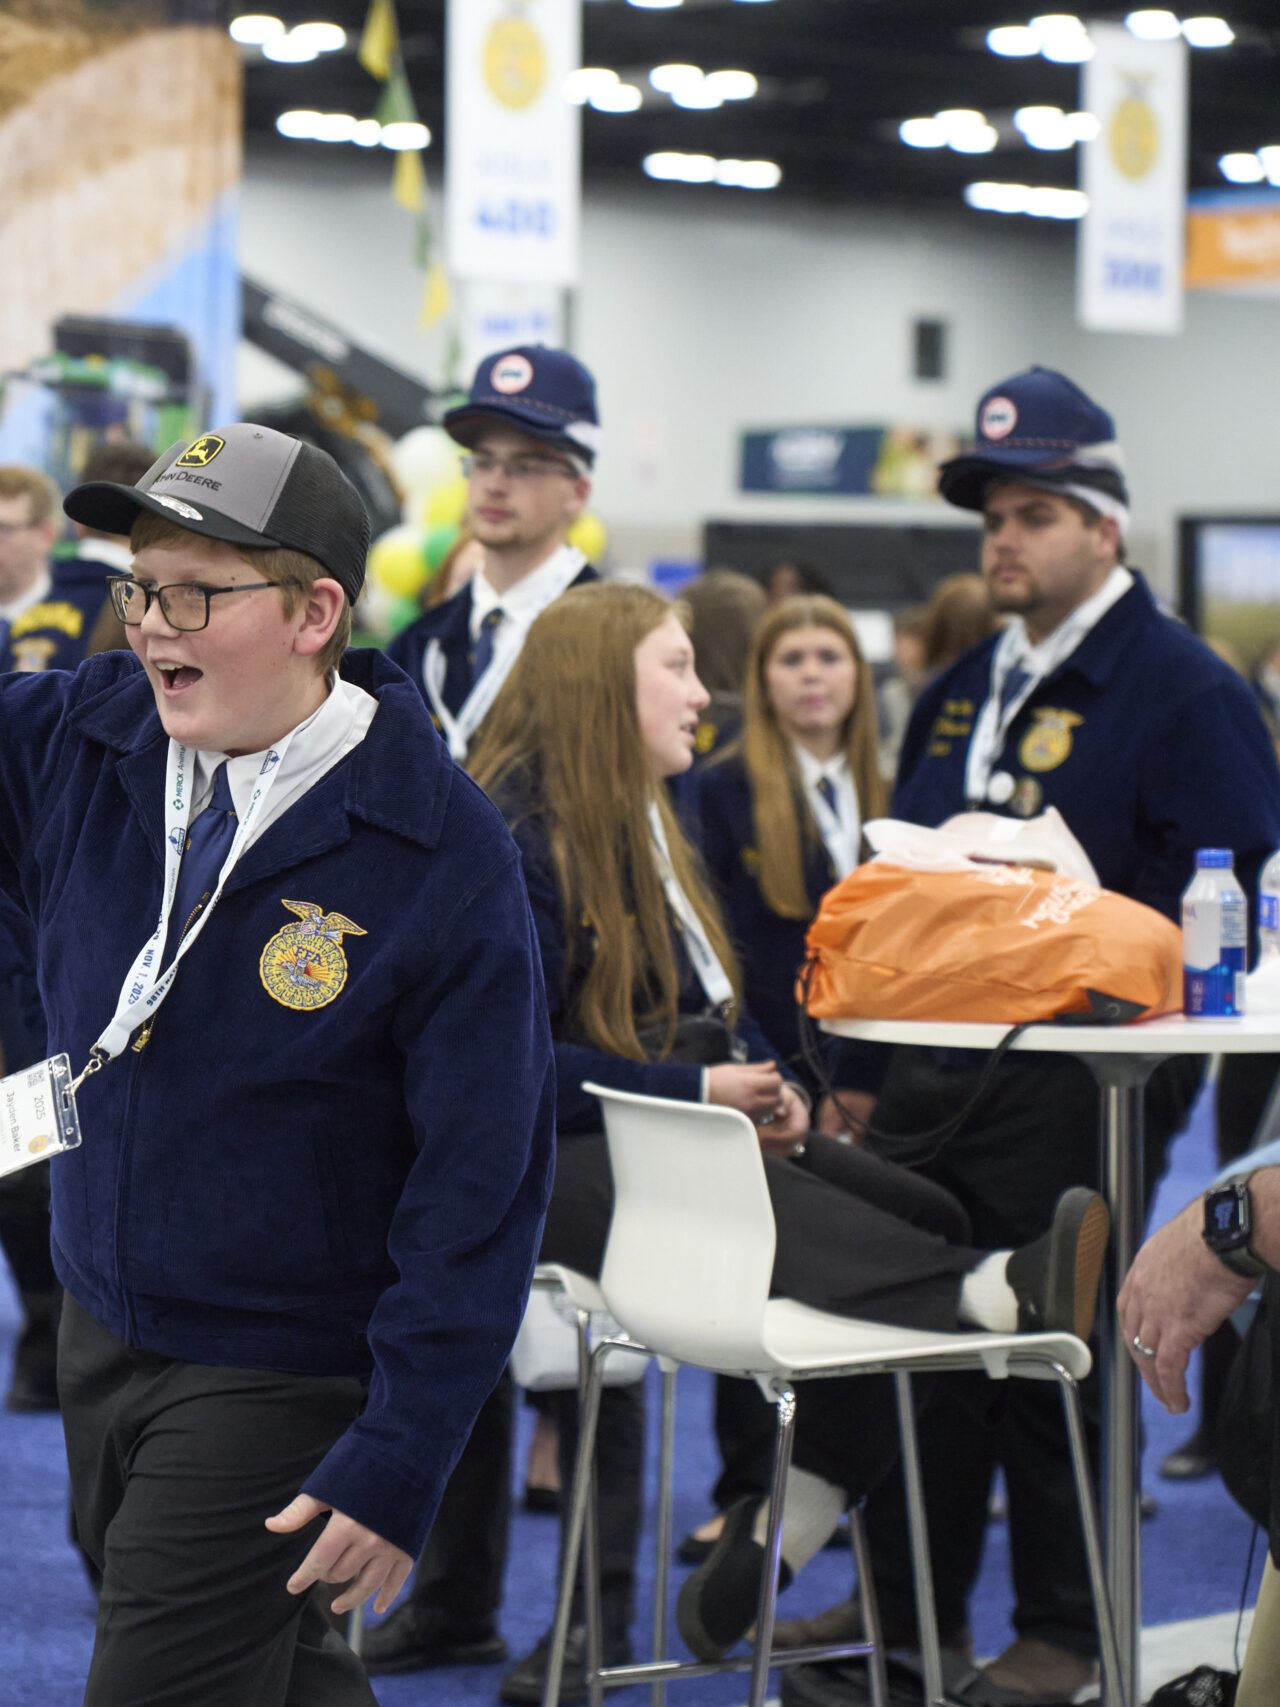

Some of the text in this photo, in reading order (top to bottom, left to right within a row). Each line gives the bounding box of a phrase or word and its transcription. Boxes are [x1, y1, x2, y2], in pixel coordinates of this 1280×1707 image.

[175, 471, 222, 491] DEERE
[176, 772, 185, 798] MERCK
[141, 949, 155, 969] NOV.
[295, 946, 322, 966] FFA
[146, 986, 165, 1006] 98TH
[33, 1095, 47, 1120] 2025
[6, 1091, 21, 1152] Jayden Baker
